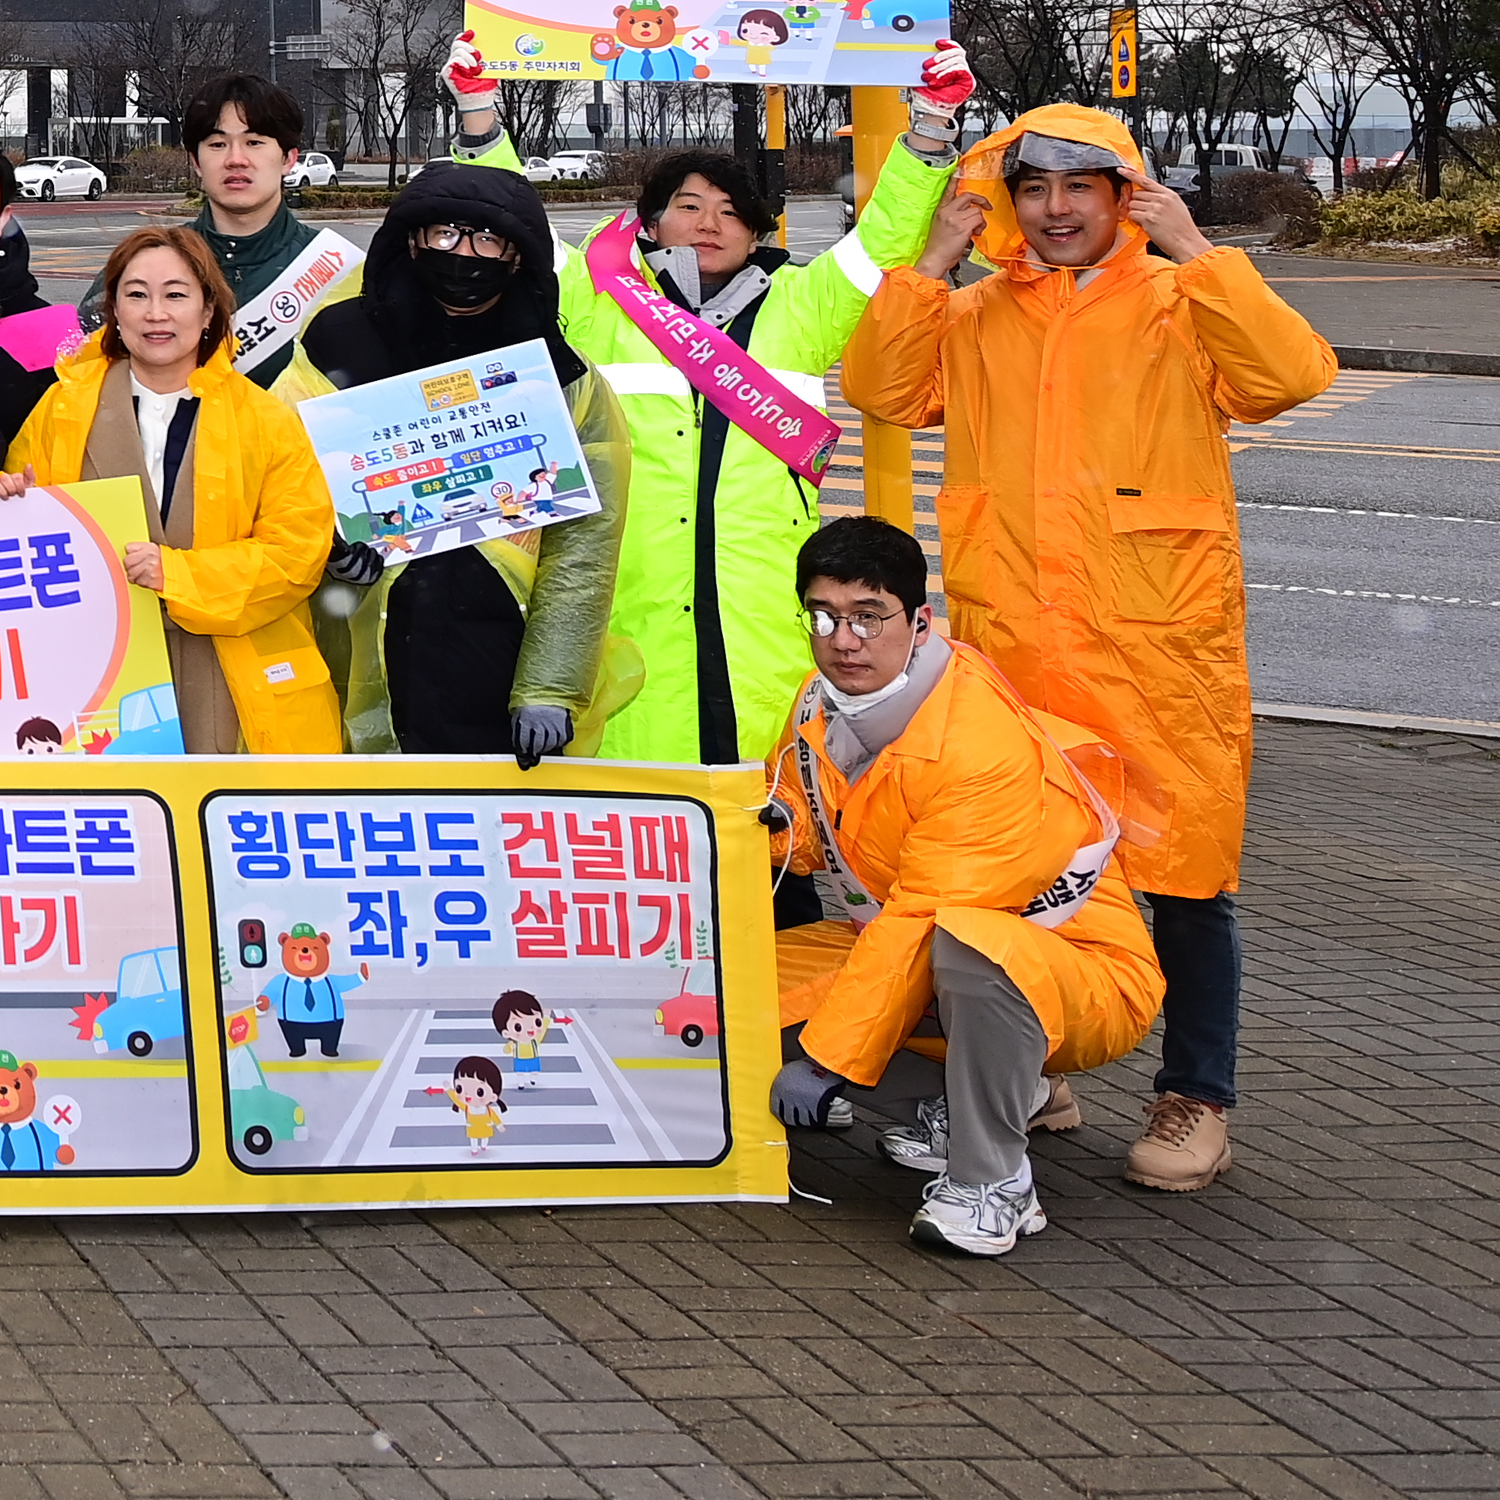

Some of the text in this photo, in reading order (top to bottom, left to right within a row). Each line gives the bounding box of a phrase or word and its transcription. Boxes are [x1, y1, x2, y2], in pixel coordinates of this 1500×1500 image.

[523, 61, 581, 71] 주민자치회
[293, 250, 344, 302] 스쿨존
[275, 296, 296, 318] 30
[372, 401, 491, 442] 스쿨존 어린이 교통안전
[714, 364, 804, 439] 송도5동
[350, 411, 529, 472] 송도5동과 함께 지켜요!
[373, 472, 394, 488] 속도
[420, 481, 443, 495] 좌우
[228, 810, 688, 882] 횡단보도 건널때
[512, 890, 692, 960] 살피기
[230, 1023, 247, 1035] STOP
